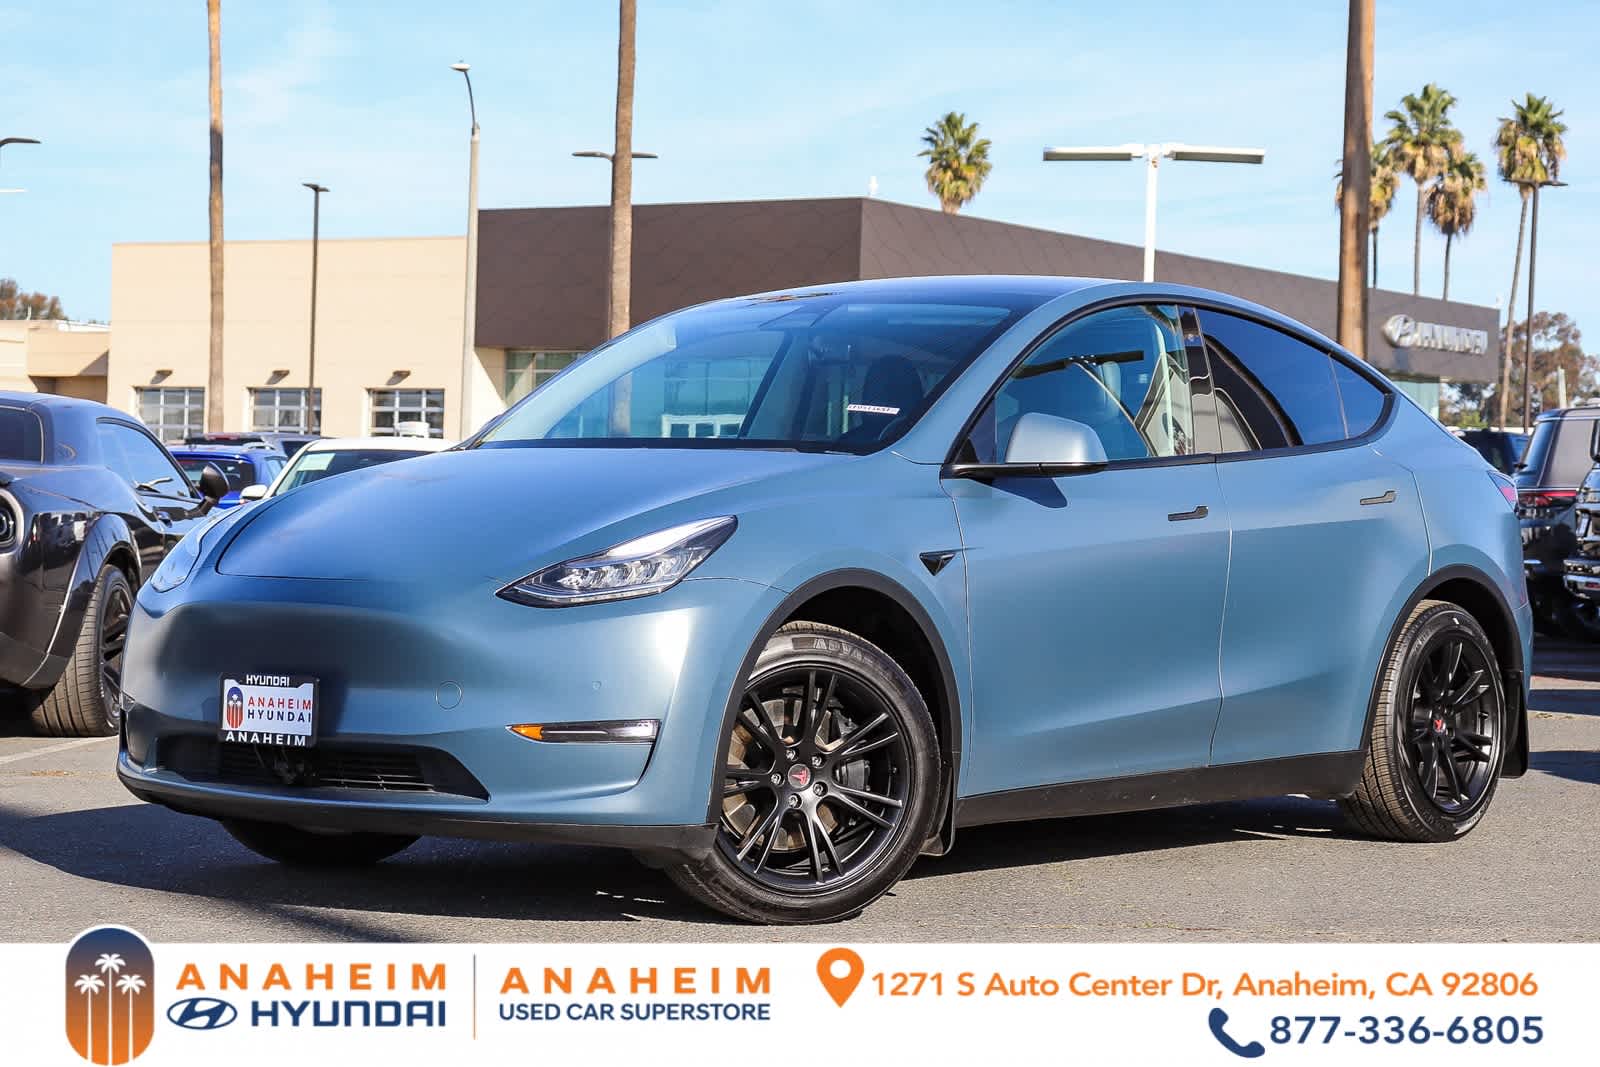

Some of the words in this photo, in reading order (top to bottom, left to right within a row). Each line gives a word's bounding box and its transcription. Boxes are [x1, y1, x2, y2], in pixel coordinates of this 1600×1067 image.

[246, 674, 290, 686] HYUNDAI
[248, 696, 312, 710] ANAHEIM
[247, 709, 311, 722] HYUNDAI
[225, 731, 306, 746] ANAHEIM
